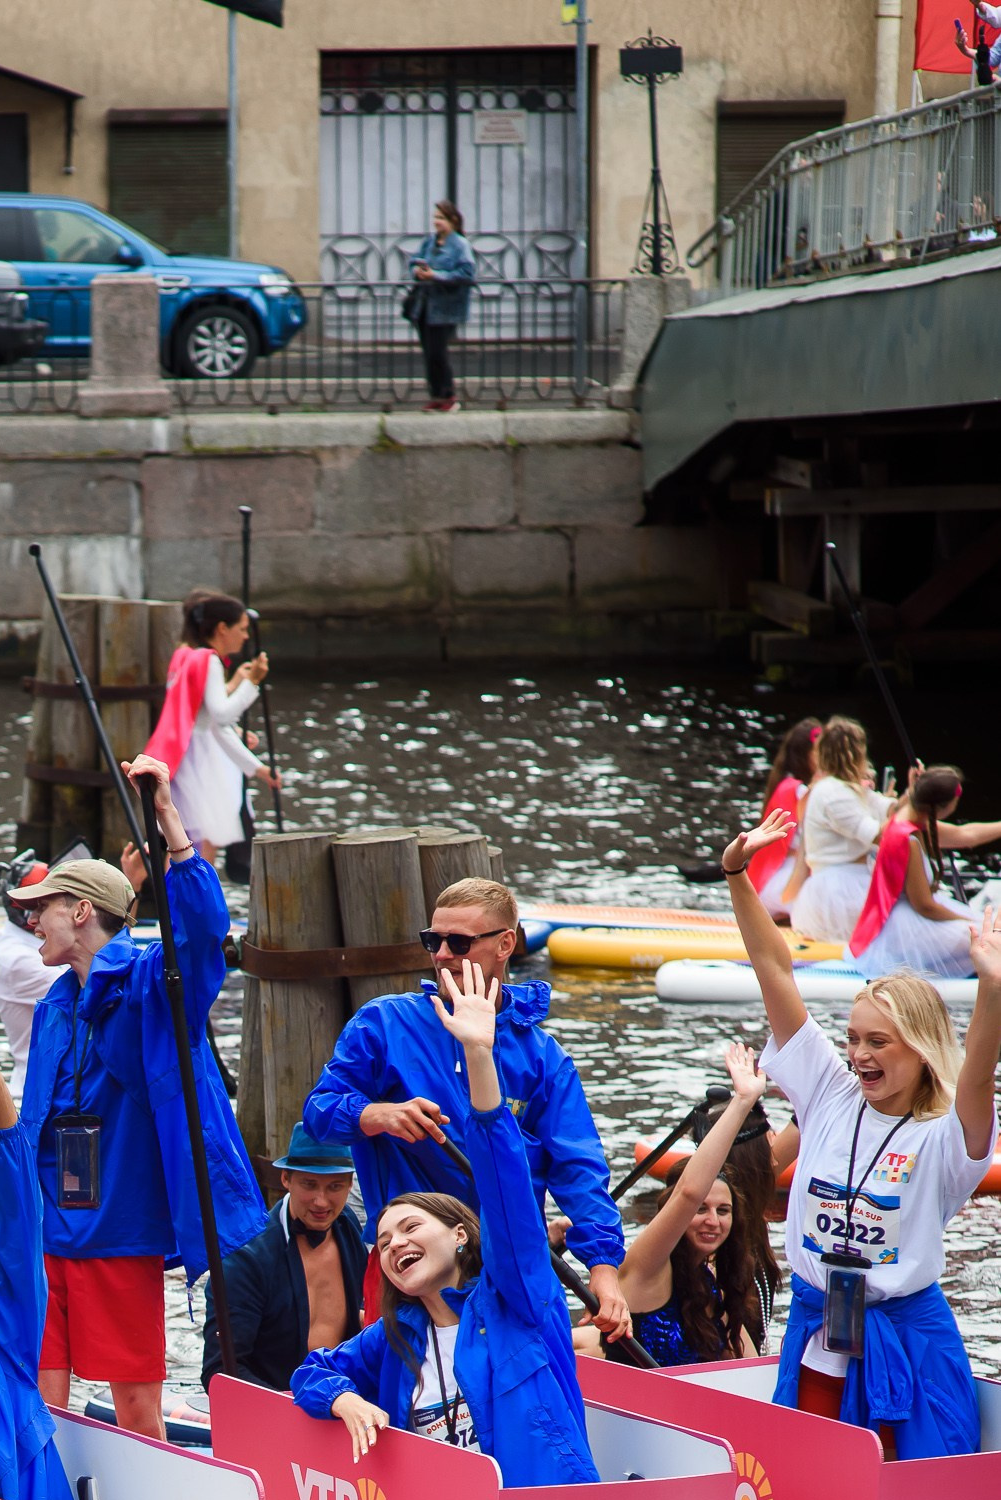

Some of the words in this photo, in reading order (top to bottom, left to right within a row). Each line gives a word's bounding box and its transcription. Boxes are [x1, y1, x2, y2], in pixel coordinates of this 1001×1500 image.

[820, 1201, 864, 1216] ФОНТКА
[865, 1212, 883, 1222] SUP
[426, 1412, 471, 1435] ФОНТКА
